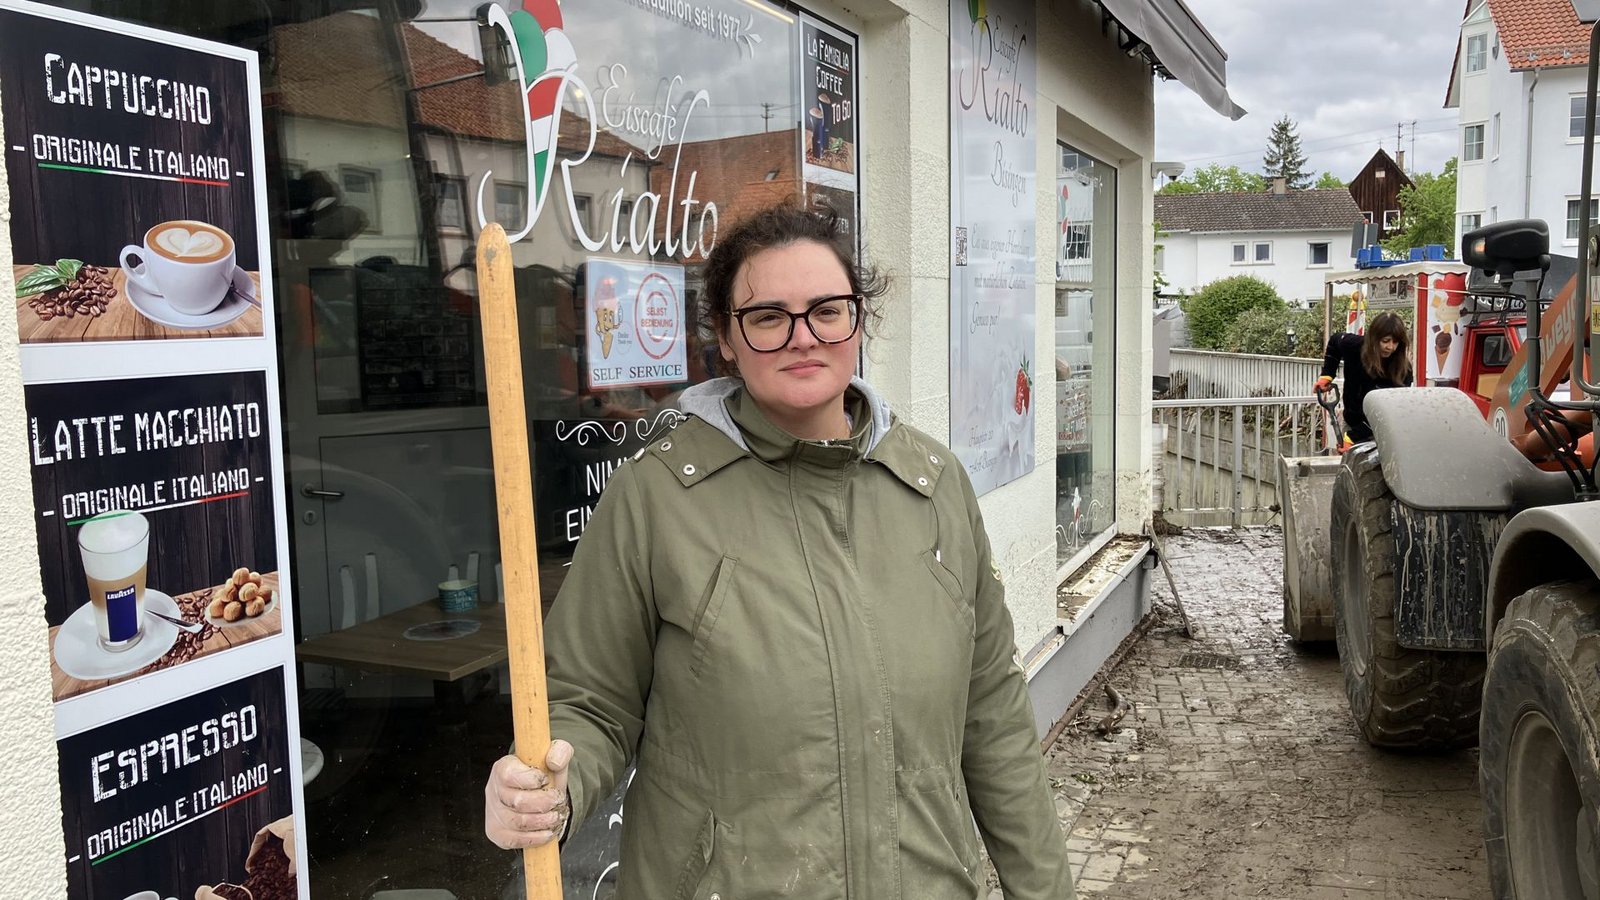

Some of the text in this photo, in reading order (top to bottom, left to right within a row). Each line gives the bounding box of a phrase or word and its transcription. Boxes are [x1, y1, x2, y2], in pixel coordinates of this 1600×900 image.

[694, 5, 715, 33] seit
[718, 11, 741, 42] 1977
[807, 33, 850, 72] LA FAMIGLIA
[959, 15, 1028, 138] Rialto
[44, 52, 212, 125] CAPPUCCINO
[815, 65, 843, 96] COFFEE
[477, 3, 719, 260] Rialto
[831, 99, 852, 125] TO GO
[33, 133, 230, 181] ORIGINALE ITALIANO
[991, 140, 1026, 208] Bisingen
[593, 364, 683, 381] SELF SERVICE
[31, 402, 261, 466] LATTE MACCHIATO
[62, 467, 250, 519] ORIGINALE ITALIANO
[107, 587, 135, 600] LAVAZZA
[90, 704, 258, 803] ESPRESSO
[87, 763, 269, 860] ORIGINALE ITALIANO
